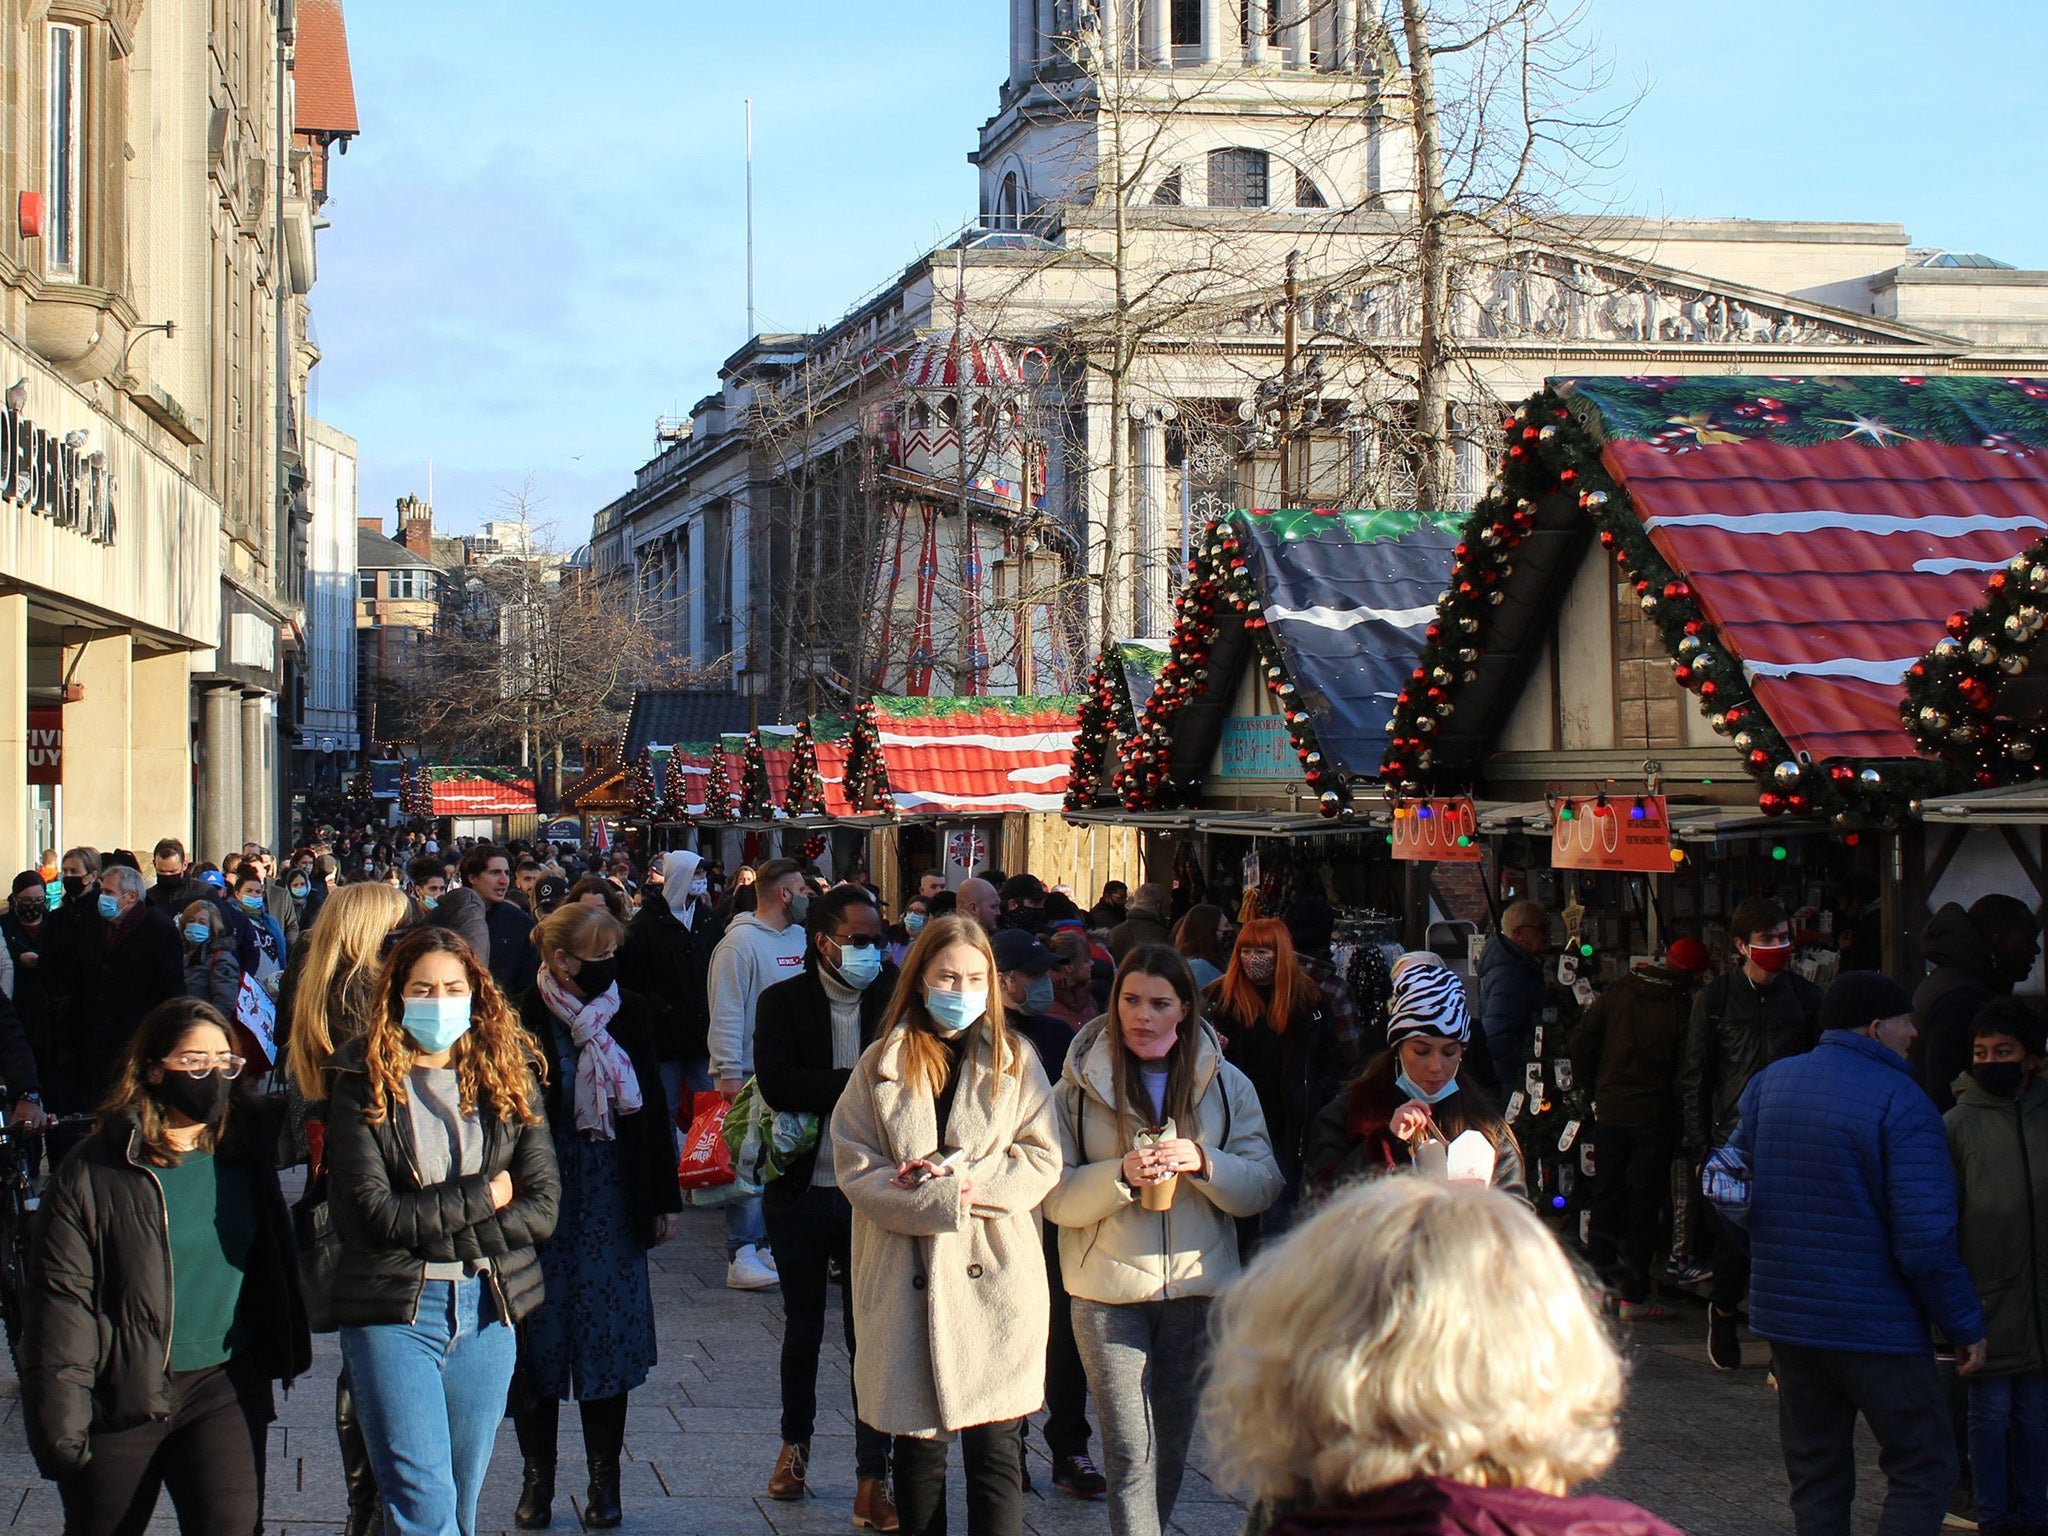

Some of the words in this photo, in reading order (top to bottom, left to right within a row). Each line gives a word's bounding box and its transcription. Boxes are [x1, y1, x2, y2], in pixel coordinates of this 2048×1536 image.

[0, 403, 117, 547] DEBENHAMS
[27, 729, 62, 746] IV
[28, 749, 62, 766] UY
